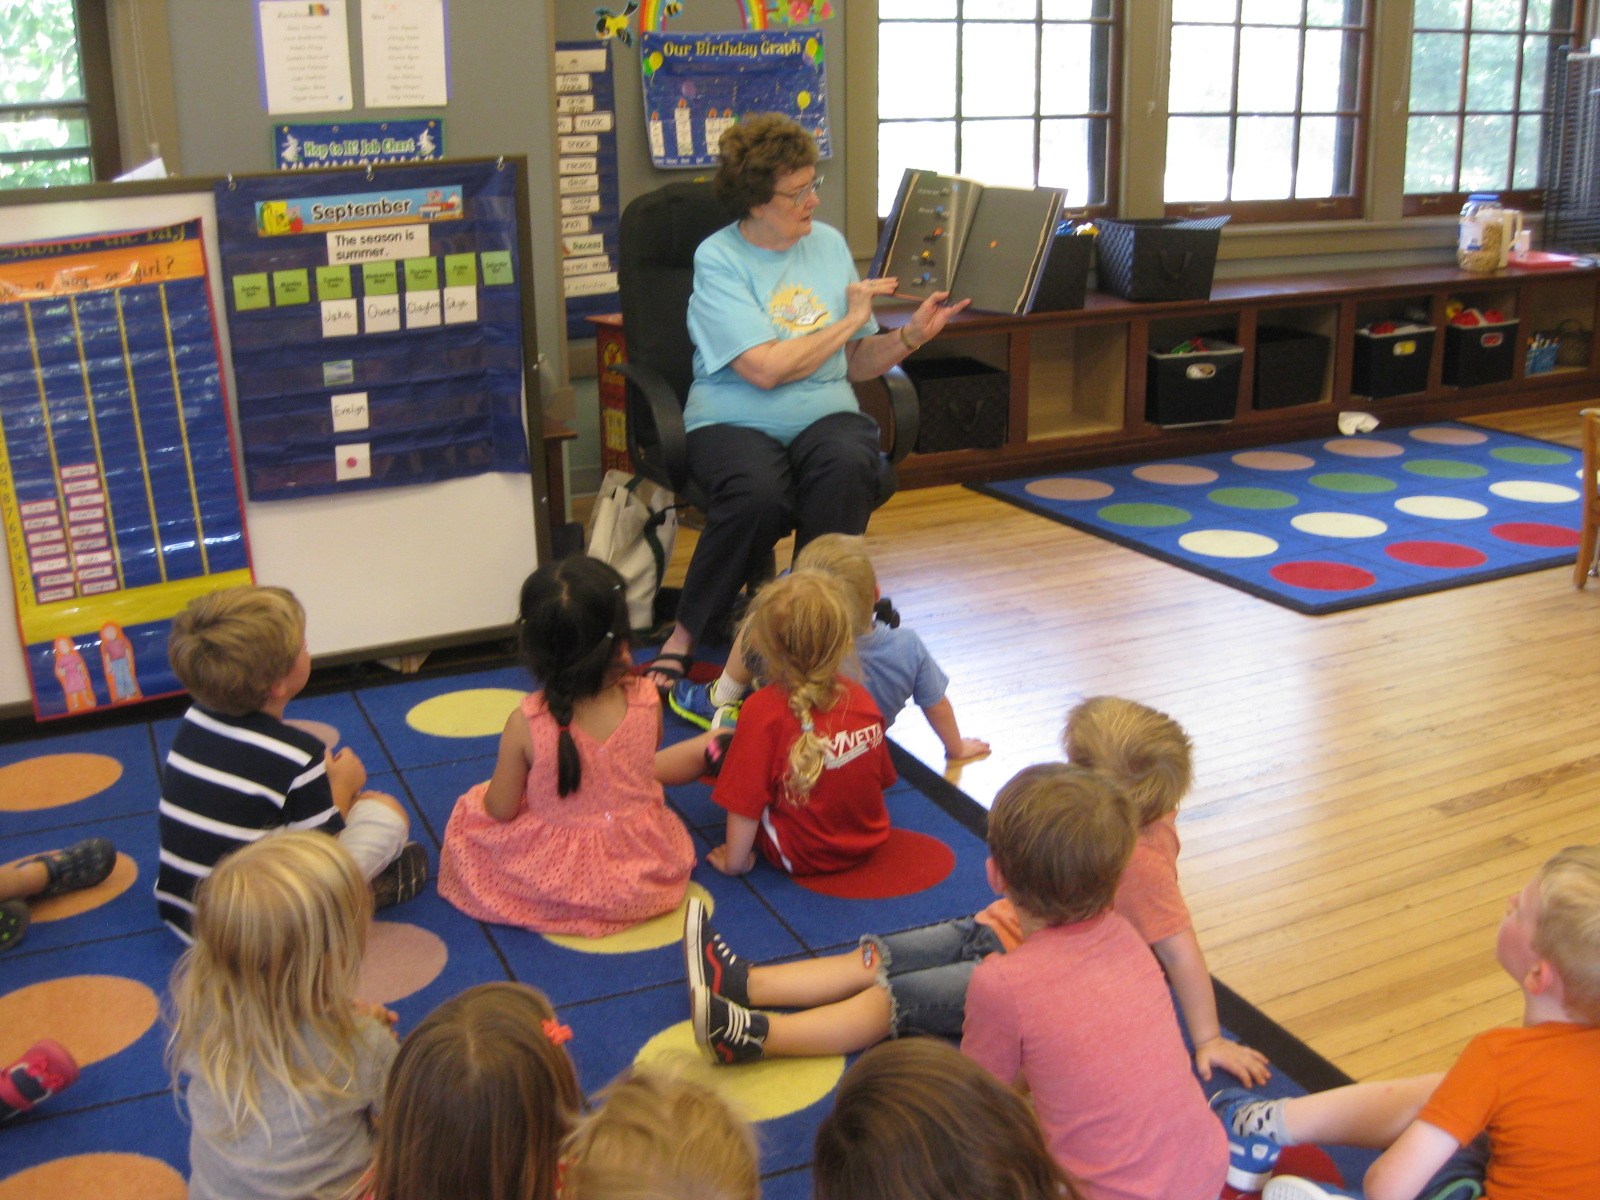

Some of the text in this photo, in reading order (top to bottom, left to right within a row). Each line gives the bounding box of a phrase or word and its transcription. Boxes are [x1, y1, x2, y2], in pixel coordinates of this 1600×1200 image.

[663, 39, 801, 59] Our Birthday Graph
[304, 141, 328, 160] Hop
[328, 141, 342, 157] to
[360, 138, 381, 157] Job
[381, 137, 416, 155] Chart
[312, 198, 411, 223] September
[335, 229, 415, 247] The season is
[336, 246, 389, 260] summer.
